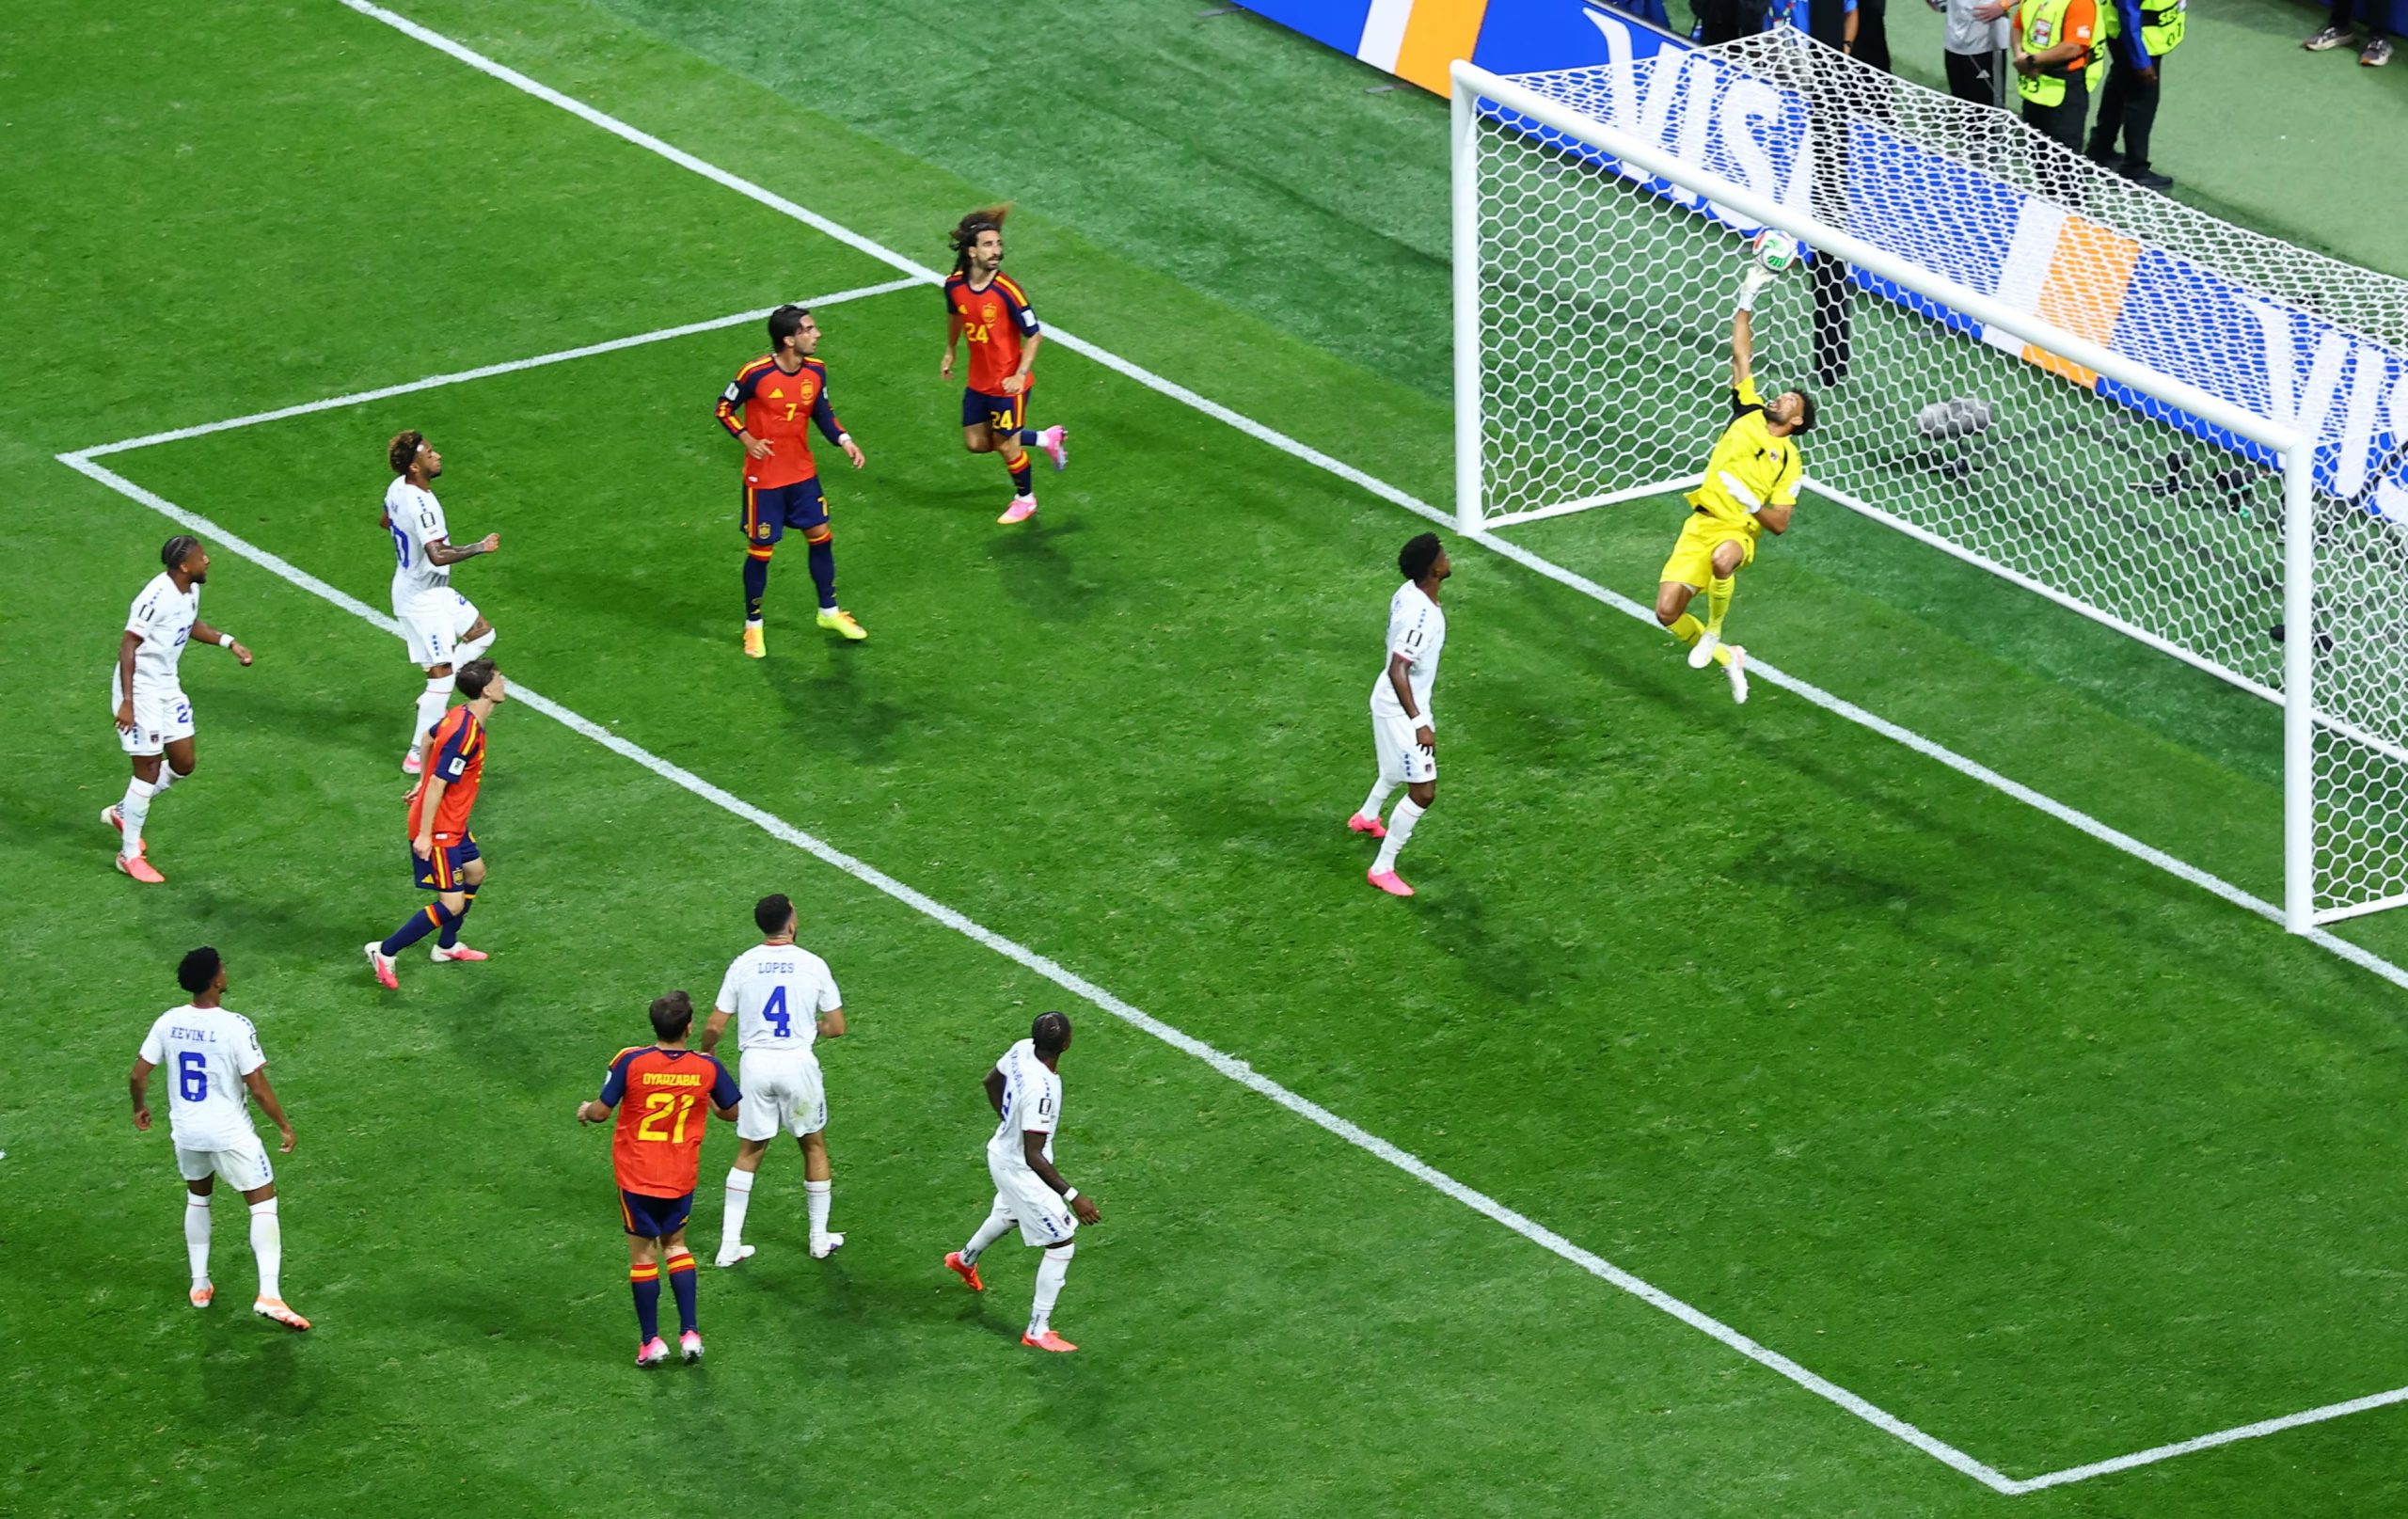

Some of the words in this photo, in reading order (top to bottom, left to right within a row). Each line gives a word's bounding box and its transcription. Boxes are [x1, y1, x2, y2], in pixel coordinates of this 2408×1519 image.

[964, 322, 990, 344] 24
[784, 403, 798, 421] 7
[990, 409, 1014, 431] 24
[758, 962, 795, 973] LOPES
[763, 985, 790, 1037] 4
[179, 1051, 208, 1102] 6
[642, 1073, 702, 1086] OYARZABAL
[638, 1092, 695, 1144] 21
